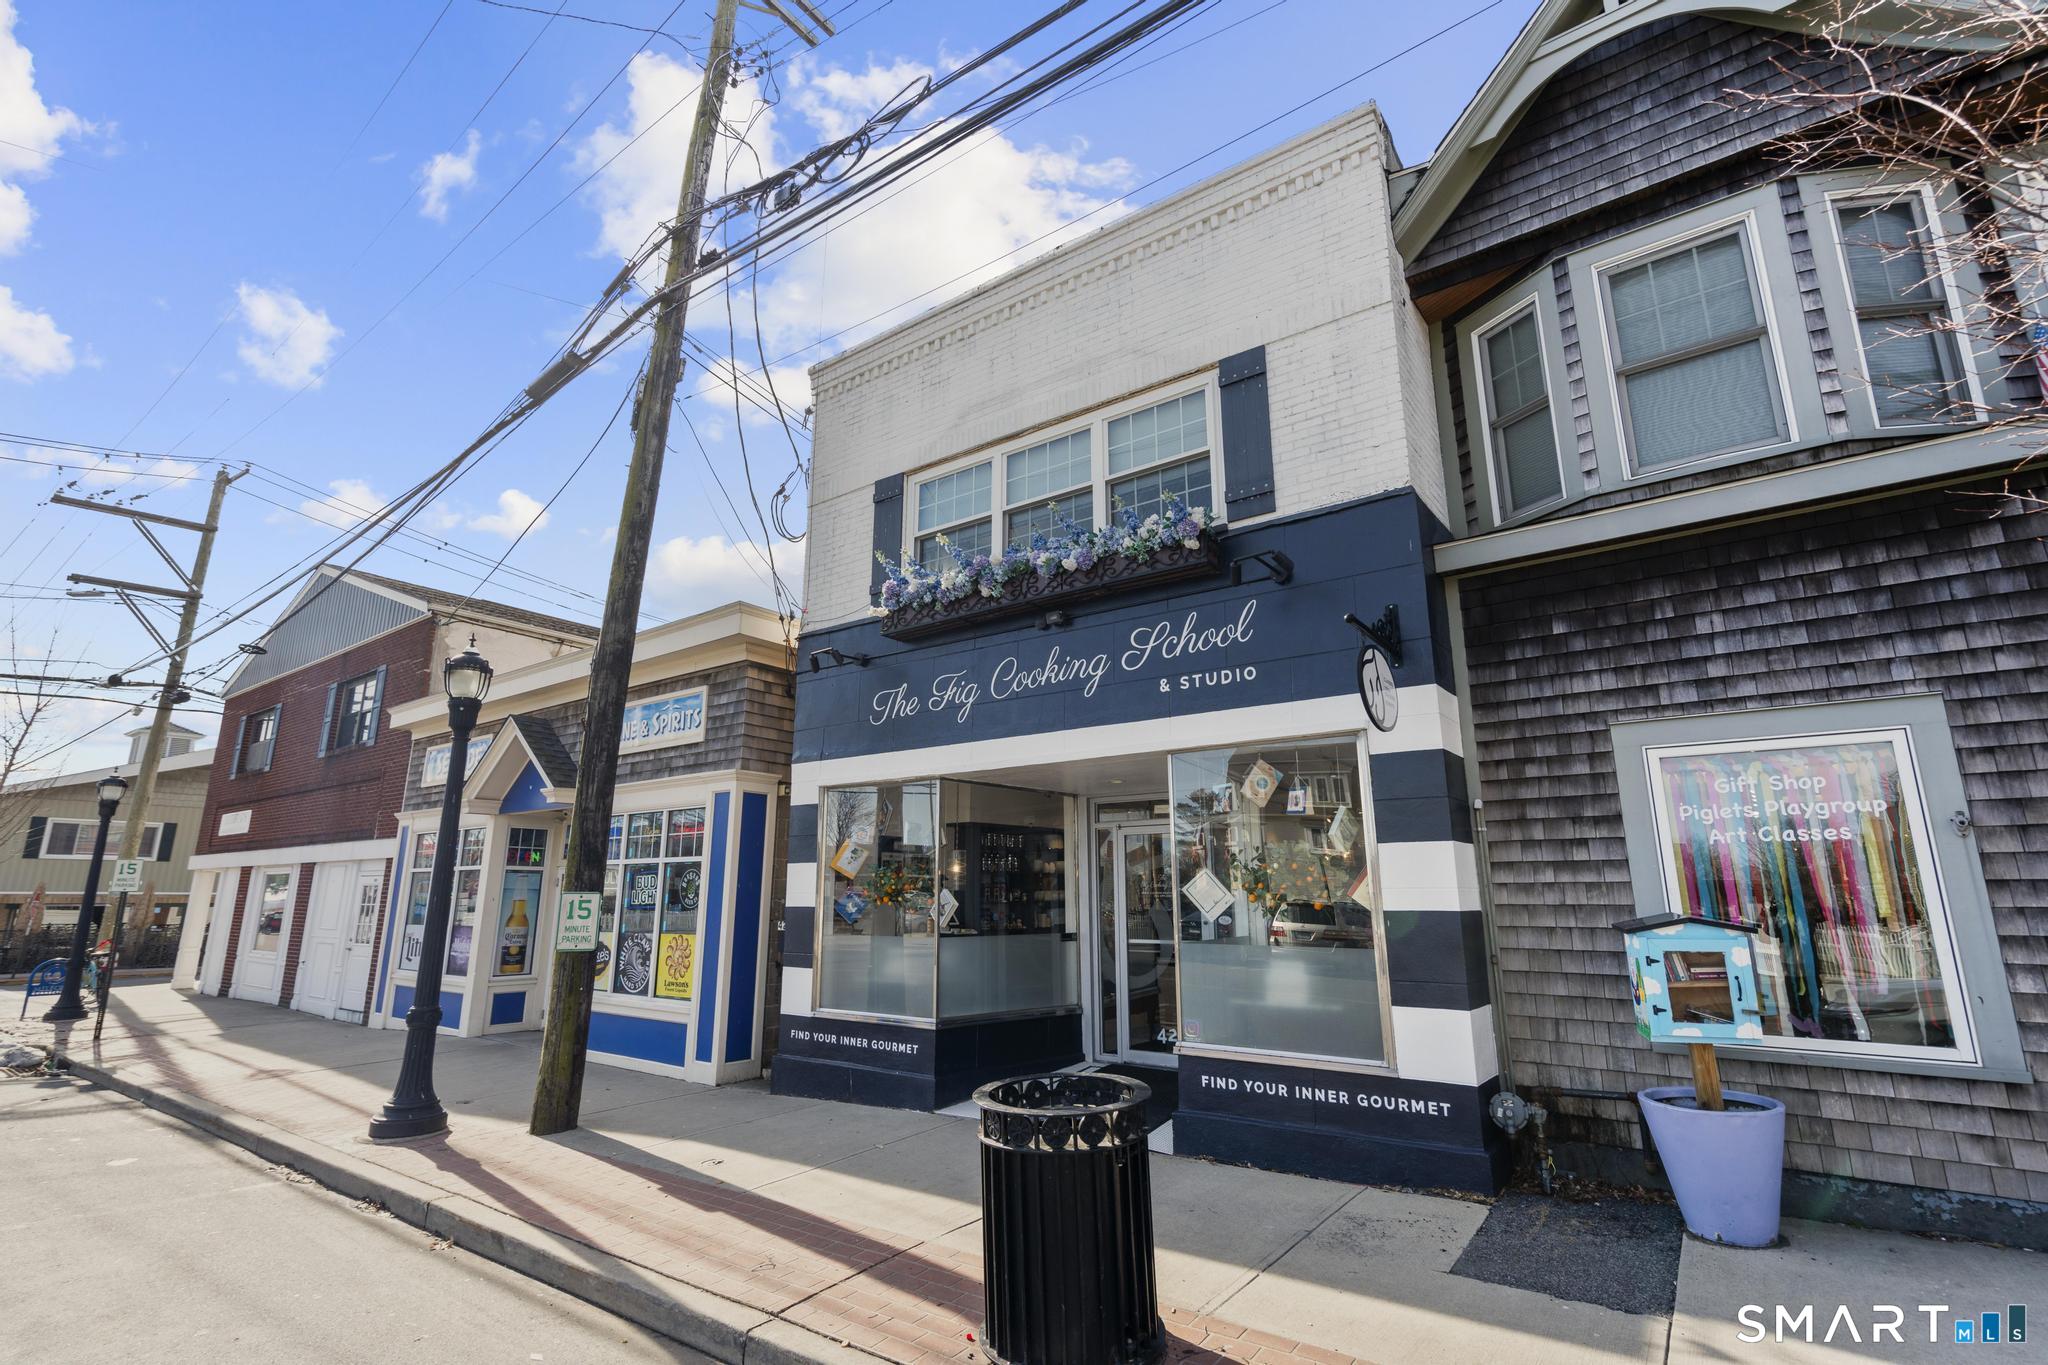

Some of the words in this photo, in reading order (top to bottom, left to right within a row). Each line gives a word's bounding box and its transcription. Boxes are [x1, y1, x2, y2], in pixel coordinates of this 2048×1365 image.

[869, 683, 921, 726] The
[928, 669, 981, 724] Fig
[990, 646, 1111, 698] Cooking
[1121, 599, 1257, 671] School
[1159, 678, 1171, 693] &
[1179, 666, 1257, 690] STUDIO
[640, 719, 650, 738] &
[653, 709, 702, 736] SPIRITS
[1713, 776, 1757, 794] Gift
[1769, 775, 1827, 796] Shop
[1679, 802, 1754, 825] Piglets
[1764, 799, 1888, 820] Playgroup
[1708, 828, 1747, 845] Art
[1757, 826, 1852, 843] Classes
[119, 863, 137, 875] 15
[636, 875, 658, 890] BUD
[566, 899, 592, 920] 15
[504, 931, 528, 941] Corona
[561, 935, 592, 943] PARKING
[564, 925, 591, 933] MINUTE
[620, 936, 633, 971] WHITE
[633, 932, 651, 953] CLAW
[664, 979, 689, 989] Lawson's
[790, 1029, 811, 1041] FIND
[813, 1032, 837, 1044] YOUR
[840, 1036, 868, 1048] INNER
[871, 1040, 919, 1055] GOURMET
[1201, 1075, 1238, 1090] FIND
[1243, 1080, 1288, 1097] YOUR
[1295, 1086, 1350, 1105] INNER
[1357, 1094, 1451, 1117] GOURMET
